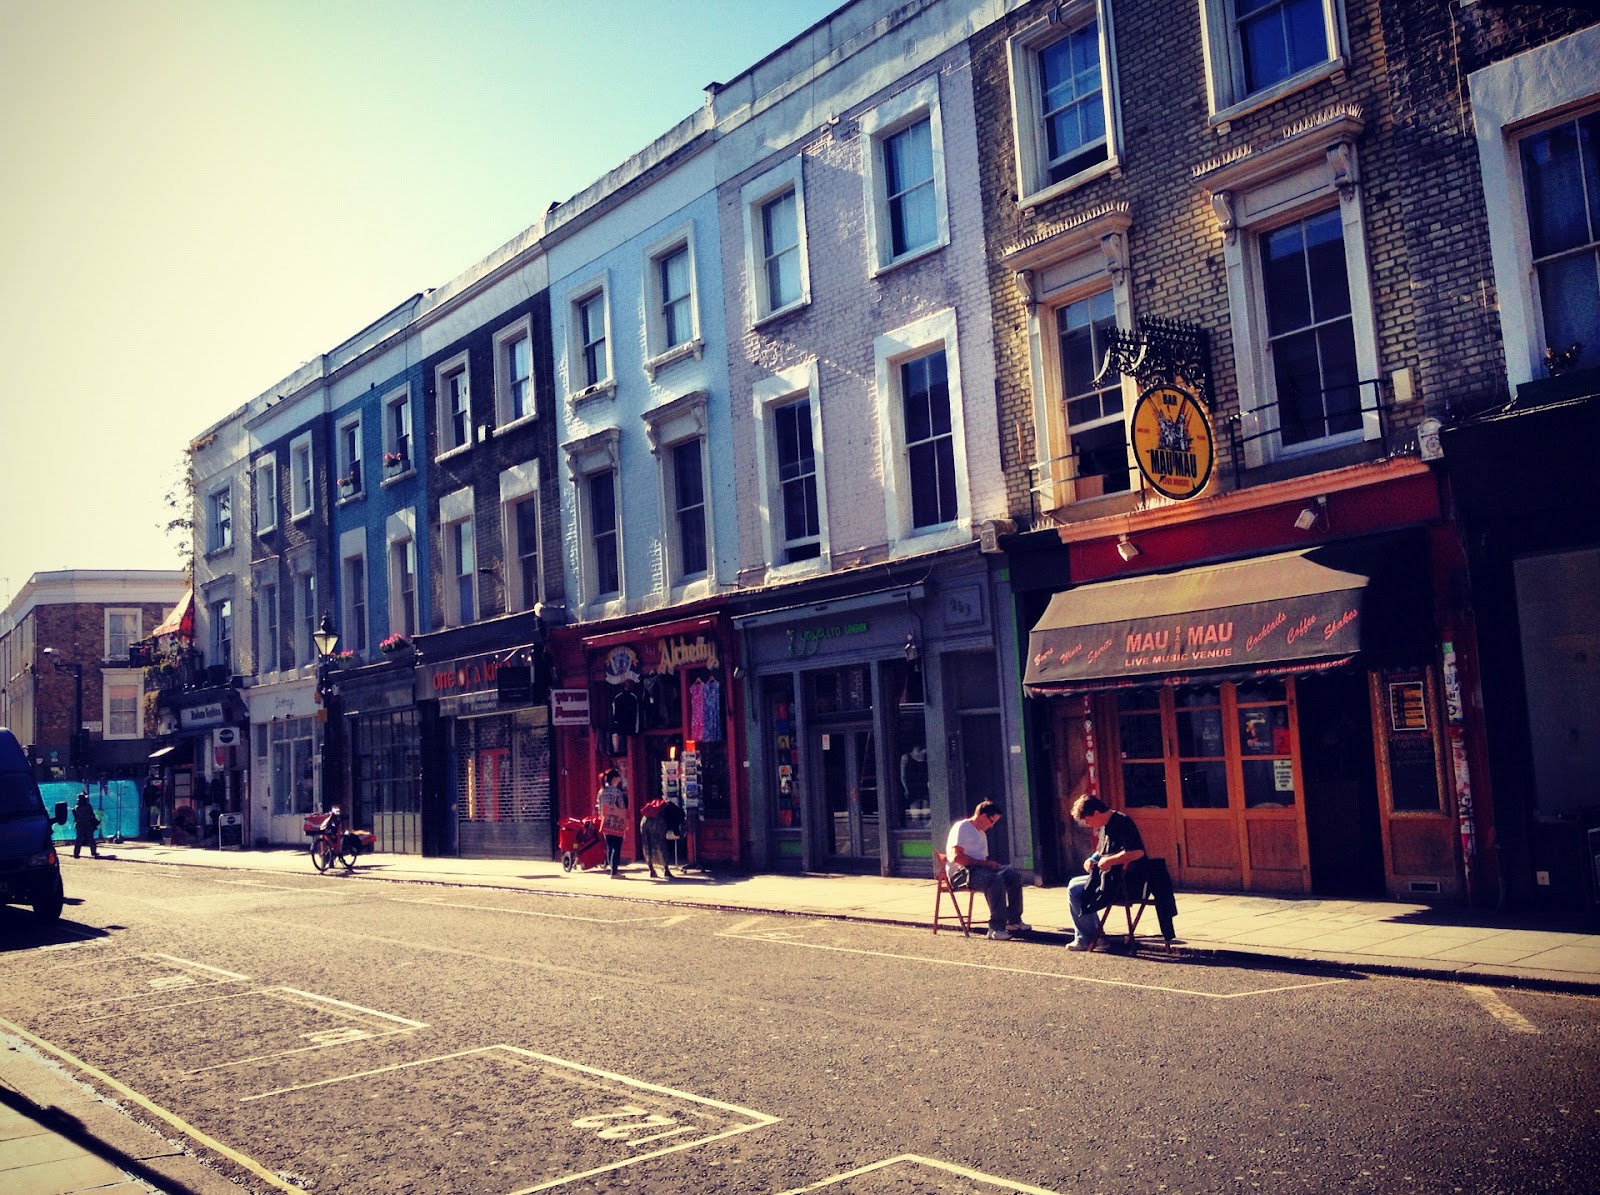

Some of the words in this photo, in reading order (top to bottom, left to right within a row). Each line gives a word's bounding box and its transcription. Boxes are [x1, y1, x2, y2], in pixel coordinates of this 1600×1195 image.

[1163, 394, 1177, 406] BAR
[1150, 449, 1173, 476] MAU
[1174, 452, 1197, 478] MAU
[1125, 630, 1169, 653] MAU
[1187, 621, 1233, 646] MAU
[1245, 612, 1287, 652] Cocktails
[1287, 615, 1317, 644] Coffee
[1324, 608, 1358, 641] Shakes
[1125, 655, 1149, 667] LIVE
[1152, 652, 1188, 664] MUSIC
[1192, 648, 1232, 660] VENUE
